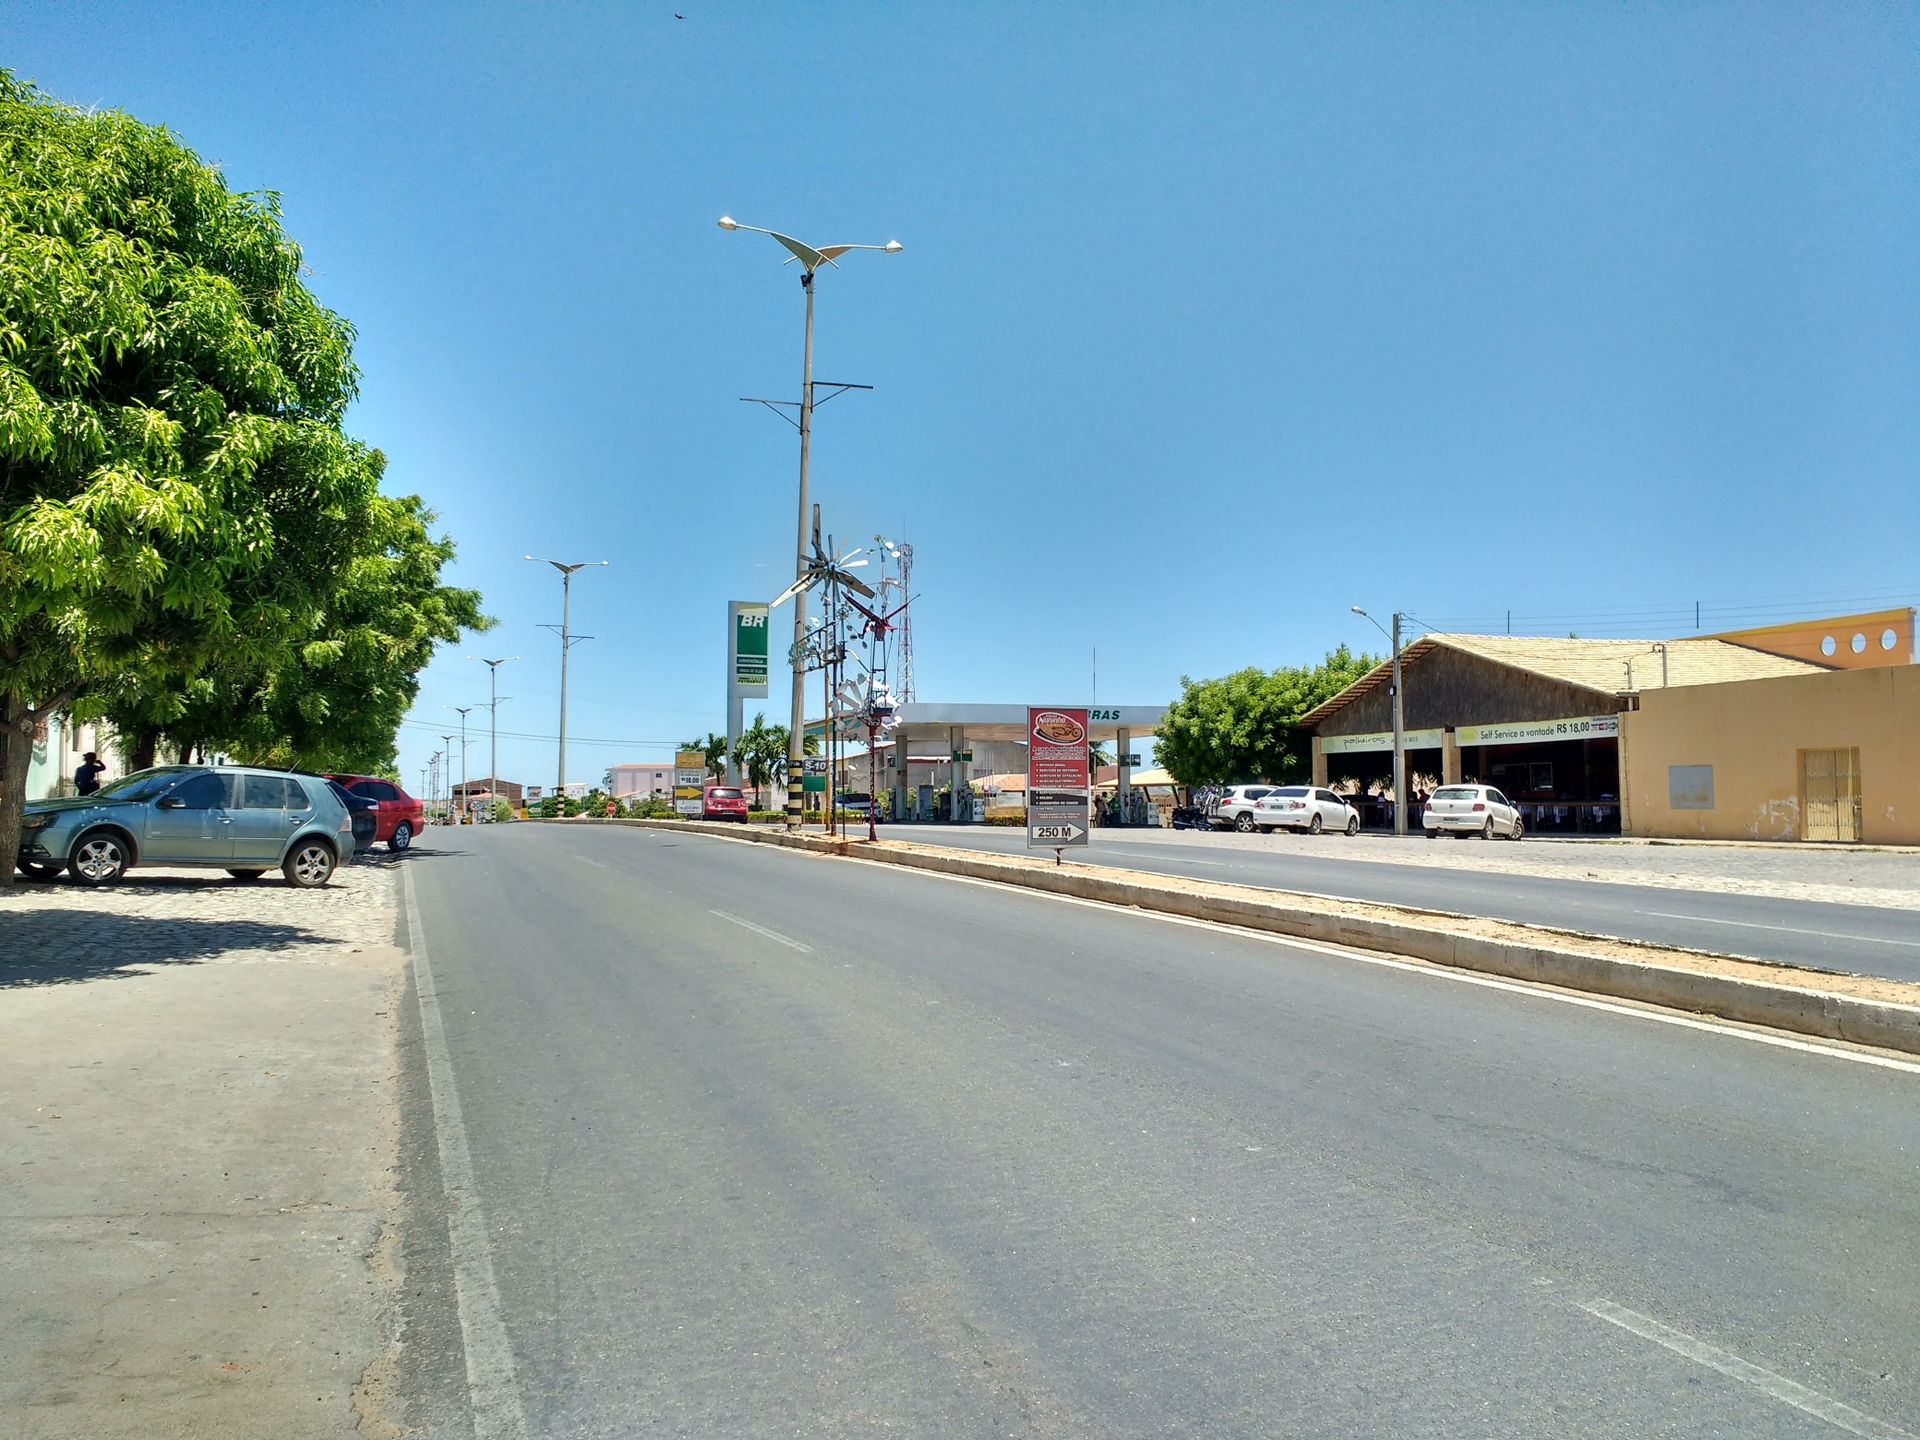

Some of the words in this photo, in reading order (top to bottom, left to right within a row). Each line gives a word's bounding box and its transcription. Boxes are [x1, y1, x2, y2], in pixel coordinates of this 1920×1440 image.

[740, 614, 765, 628] BR
[1480, 730, 1493, 740] Self
[1494, 730, 1518, 739] Service
[1526, 725, 1554, 737] vontade
[1556, 723, 1567, 734] R$
[1569, 721, 1590, 733] 18,00
[1038, 827, 1058, 837] 250
[1061, 827, 1071, 837] M
